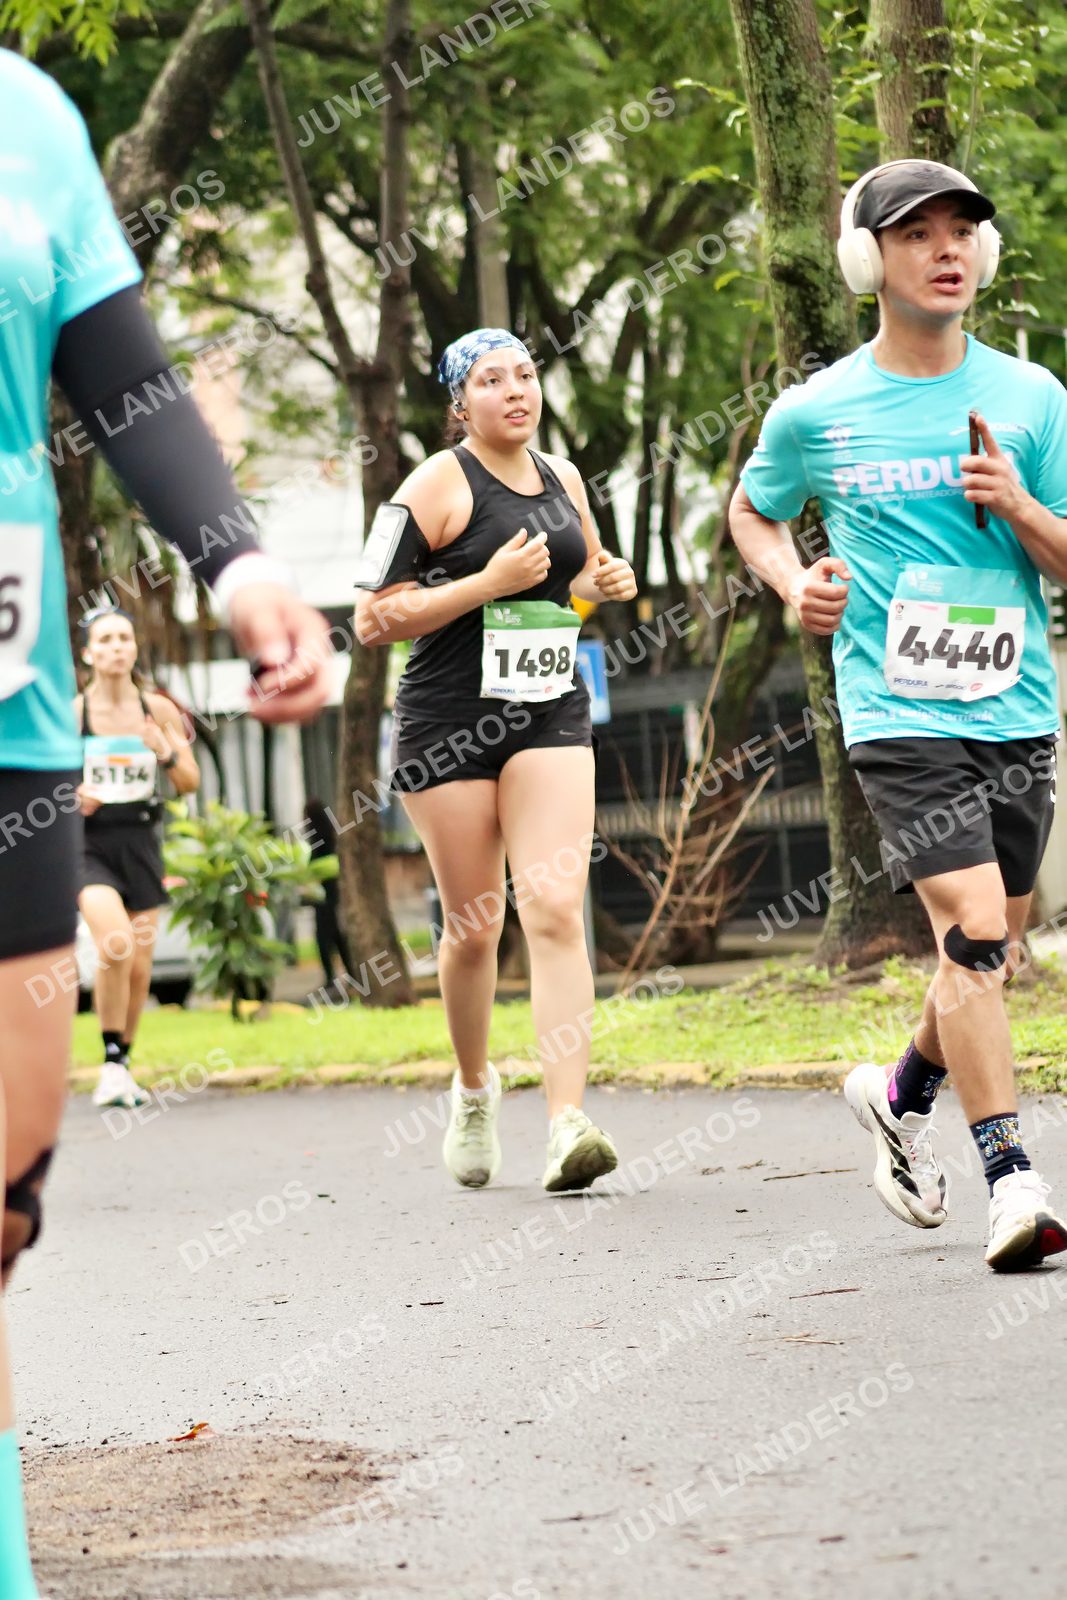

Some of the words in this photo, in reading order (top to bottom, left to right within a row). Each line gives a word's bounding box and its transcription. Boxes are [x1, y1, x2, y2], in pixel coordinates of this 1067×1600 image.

[832, 452, 1021, 497] PERDU
[494, 645, 571, 678] 1498
[897, 625, 1015, 671] 4440
[91, 767, 149, 784] 5154
